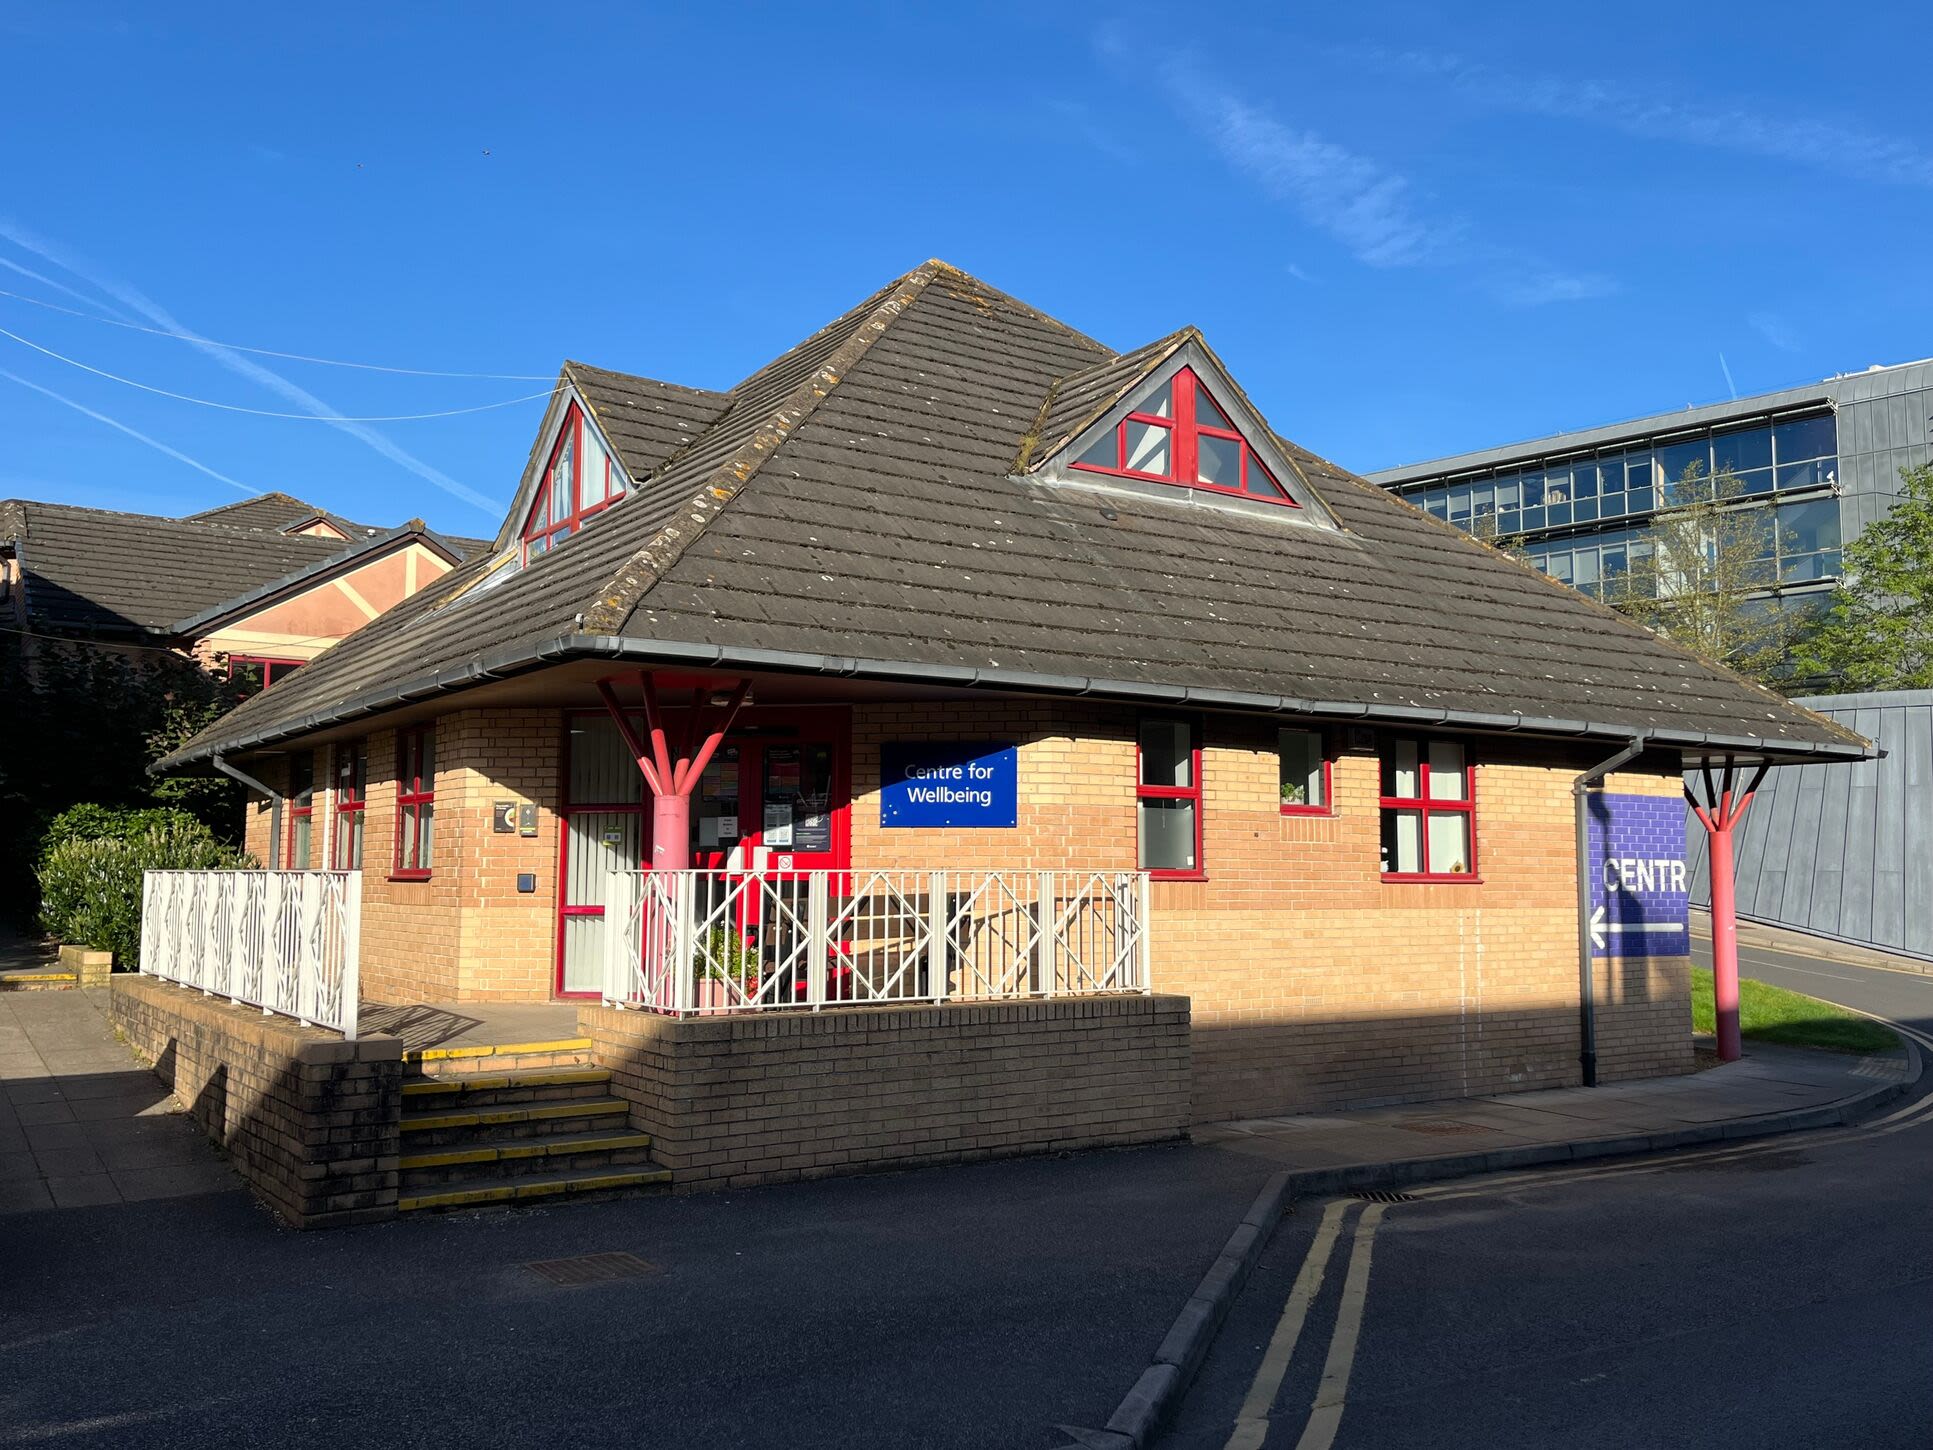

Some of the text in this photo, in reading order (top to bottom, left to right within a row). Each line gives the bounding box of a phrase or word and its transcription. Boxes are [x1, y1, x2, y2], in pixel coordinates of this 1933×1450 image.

[904, 762, 994, 780] Centre for
[906, 786, 993, 807] Wellbeing
[1603, 857, 1688, 893] CENTR
